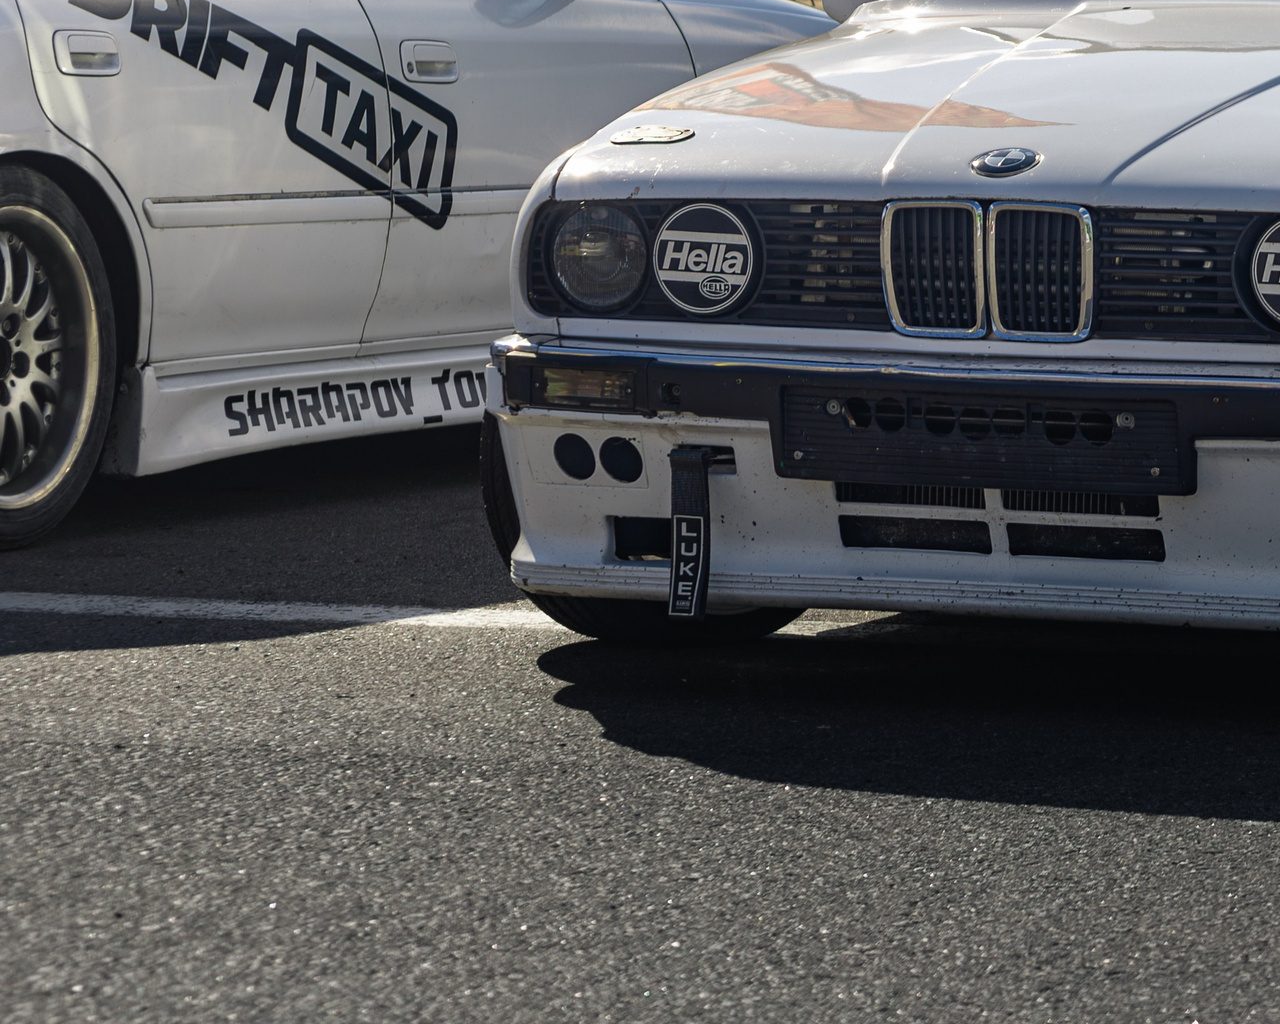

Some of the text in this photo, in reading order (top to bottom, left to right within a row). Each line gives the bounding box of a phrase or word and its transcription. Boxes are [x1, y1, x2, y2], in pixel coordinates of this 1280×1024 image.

[315, 61, 438, 197] TAXI
[662, 241, 744, 274] Hella
[702, 282, 729, 293] HELLA
[677, 521, 697, 596] LUKE
